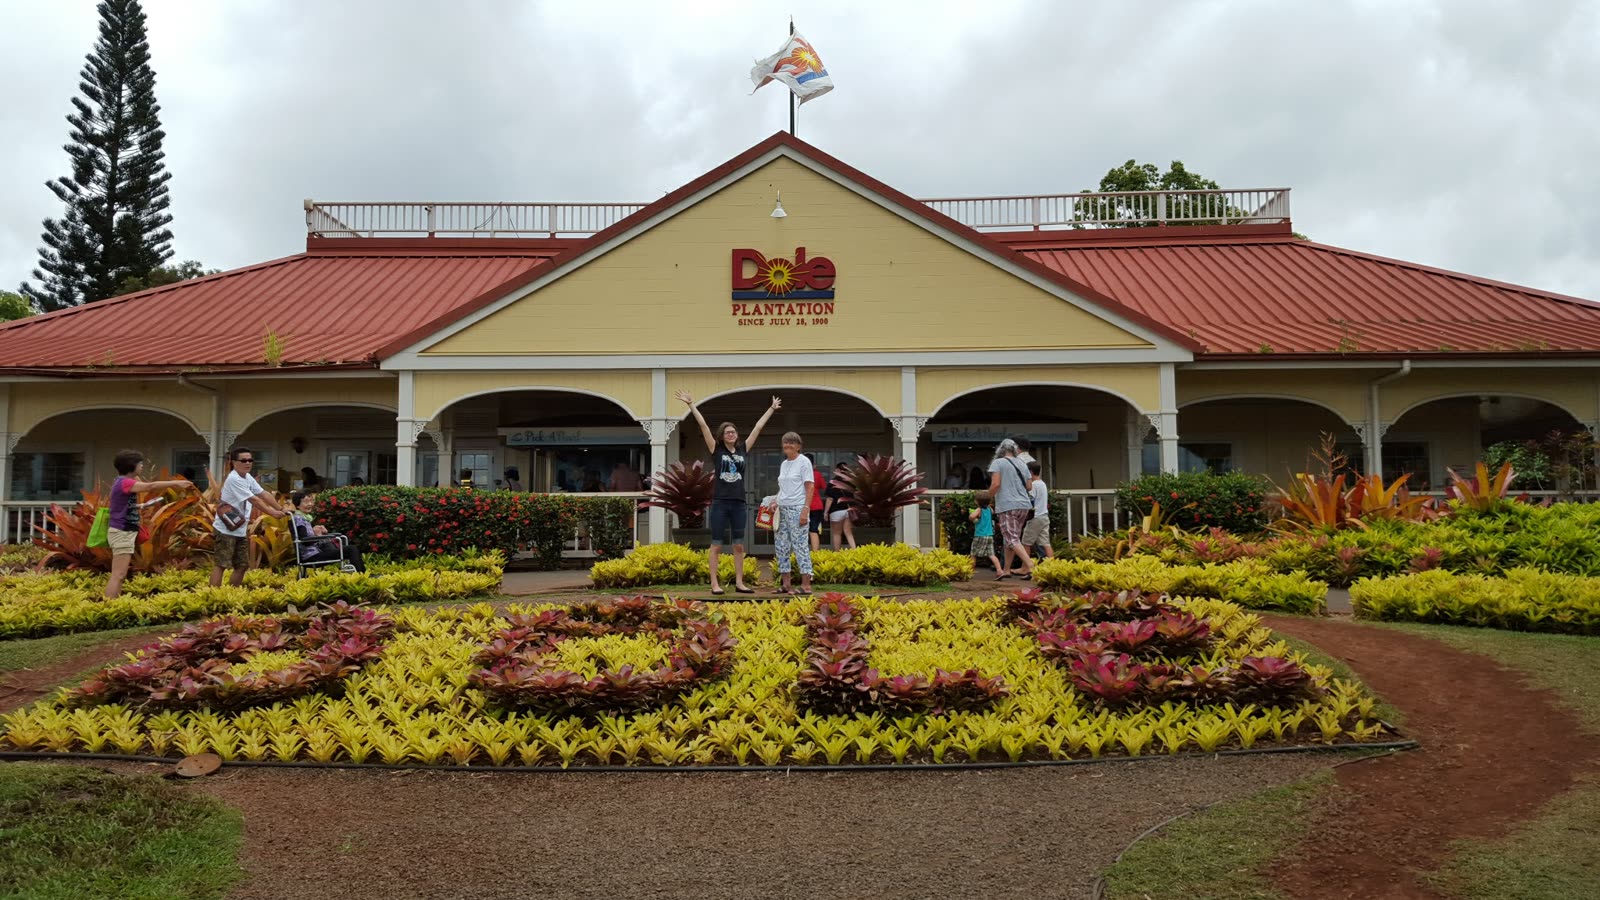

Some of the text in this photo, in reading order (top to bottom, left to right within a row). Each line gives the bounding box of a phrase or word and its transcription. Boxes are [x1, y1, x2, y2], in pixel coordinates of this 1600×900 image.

[732, 247, 836, 293] Dole
[732, 303, 835, 316] PLANTATION
[738, 318, 764, 326] SINCE
[770, 318, 790, 326] JULY
[812, 317, 829, 325] 1900
